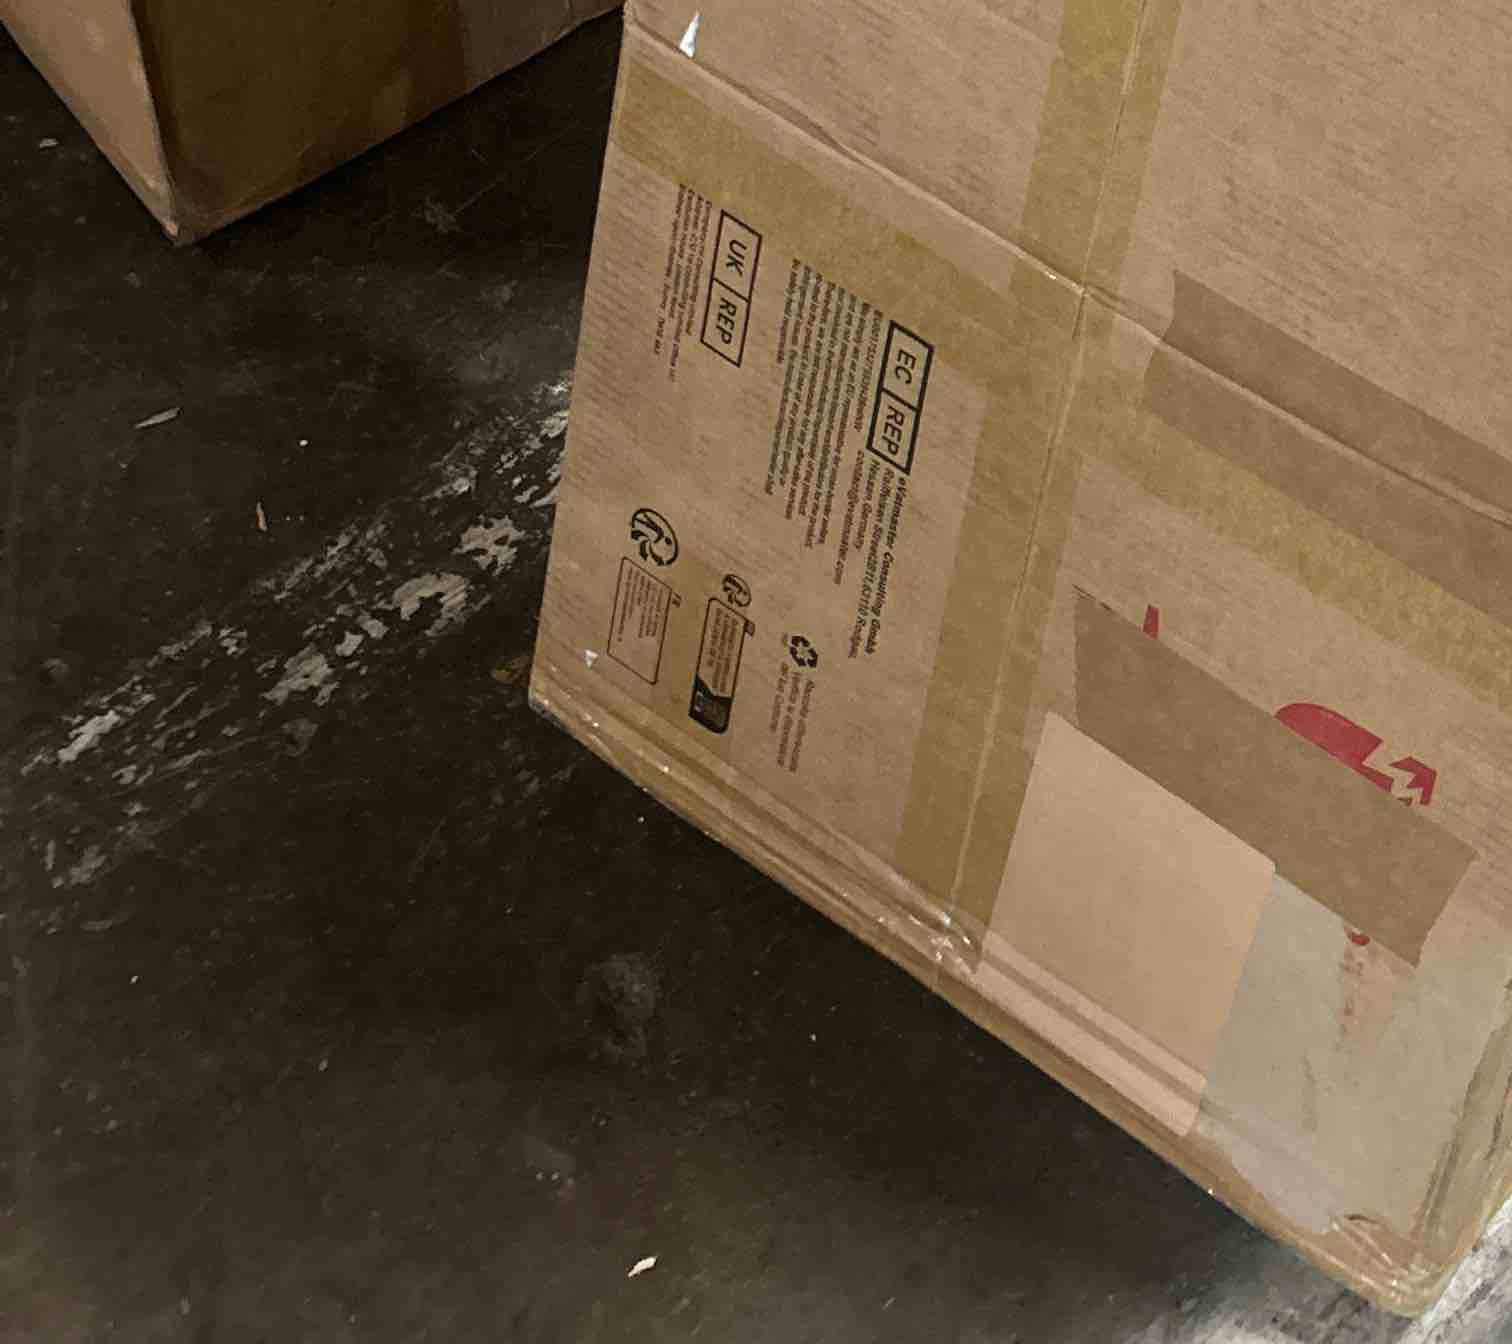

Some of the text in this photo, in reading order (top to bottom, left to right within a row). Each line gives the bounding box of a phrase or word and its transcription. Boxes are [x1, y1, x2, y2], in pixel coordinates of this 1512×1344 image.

[713, 236, 748, 347] UK REP
[879, 347, 916, 457] EC REP
